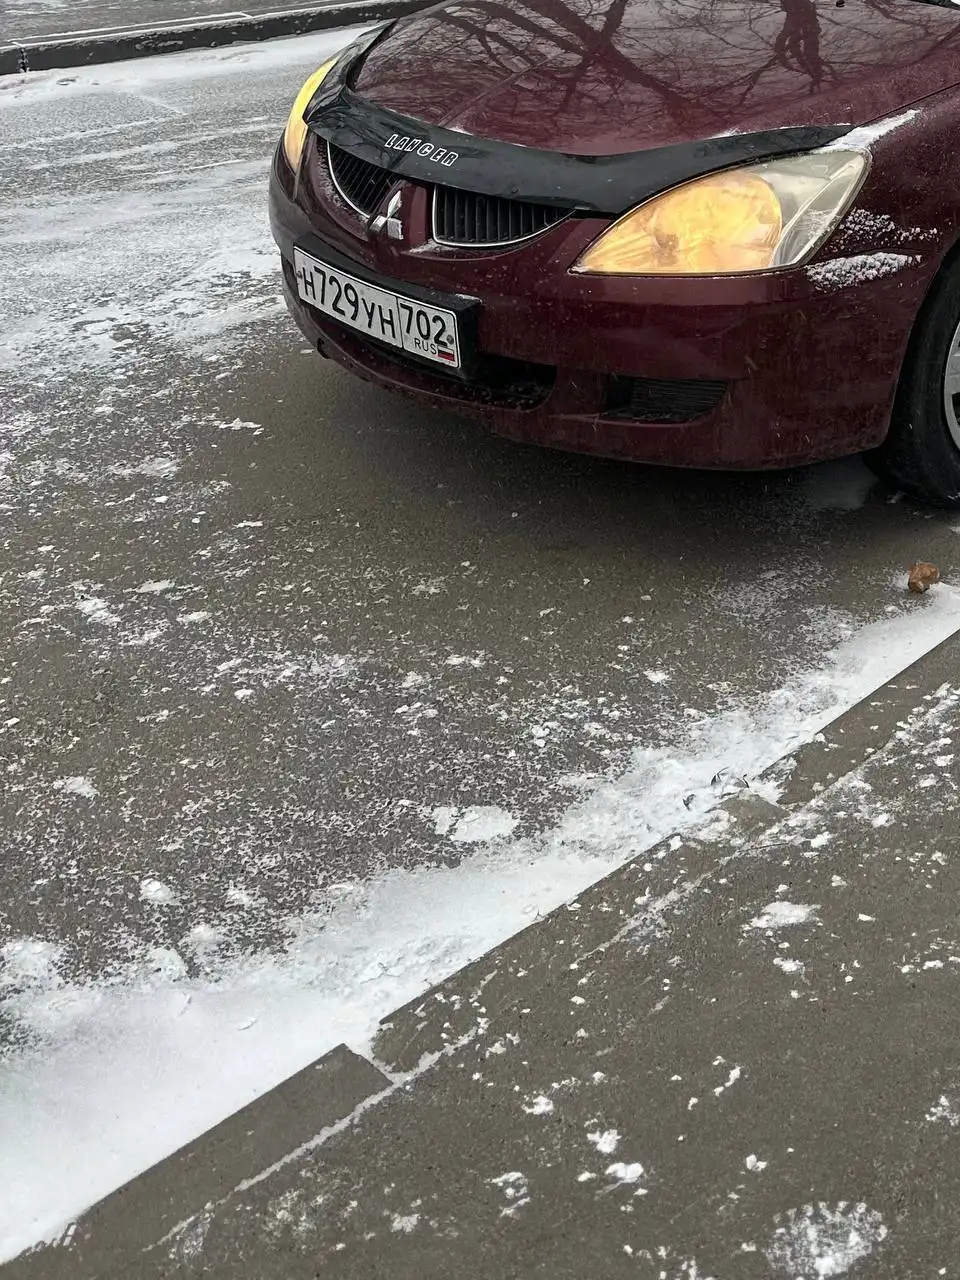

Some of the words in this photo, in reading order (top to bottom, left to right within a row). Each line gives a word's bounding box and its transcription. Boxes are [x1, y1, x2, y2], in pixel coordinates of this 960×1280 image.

[384, 133, 459, 167] LANCER
[400, 302, 448, 347] 702
[414, 338, 437, 355] RUS
